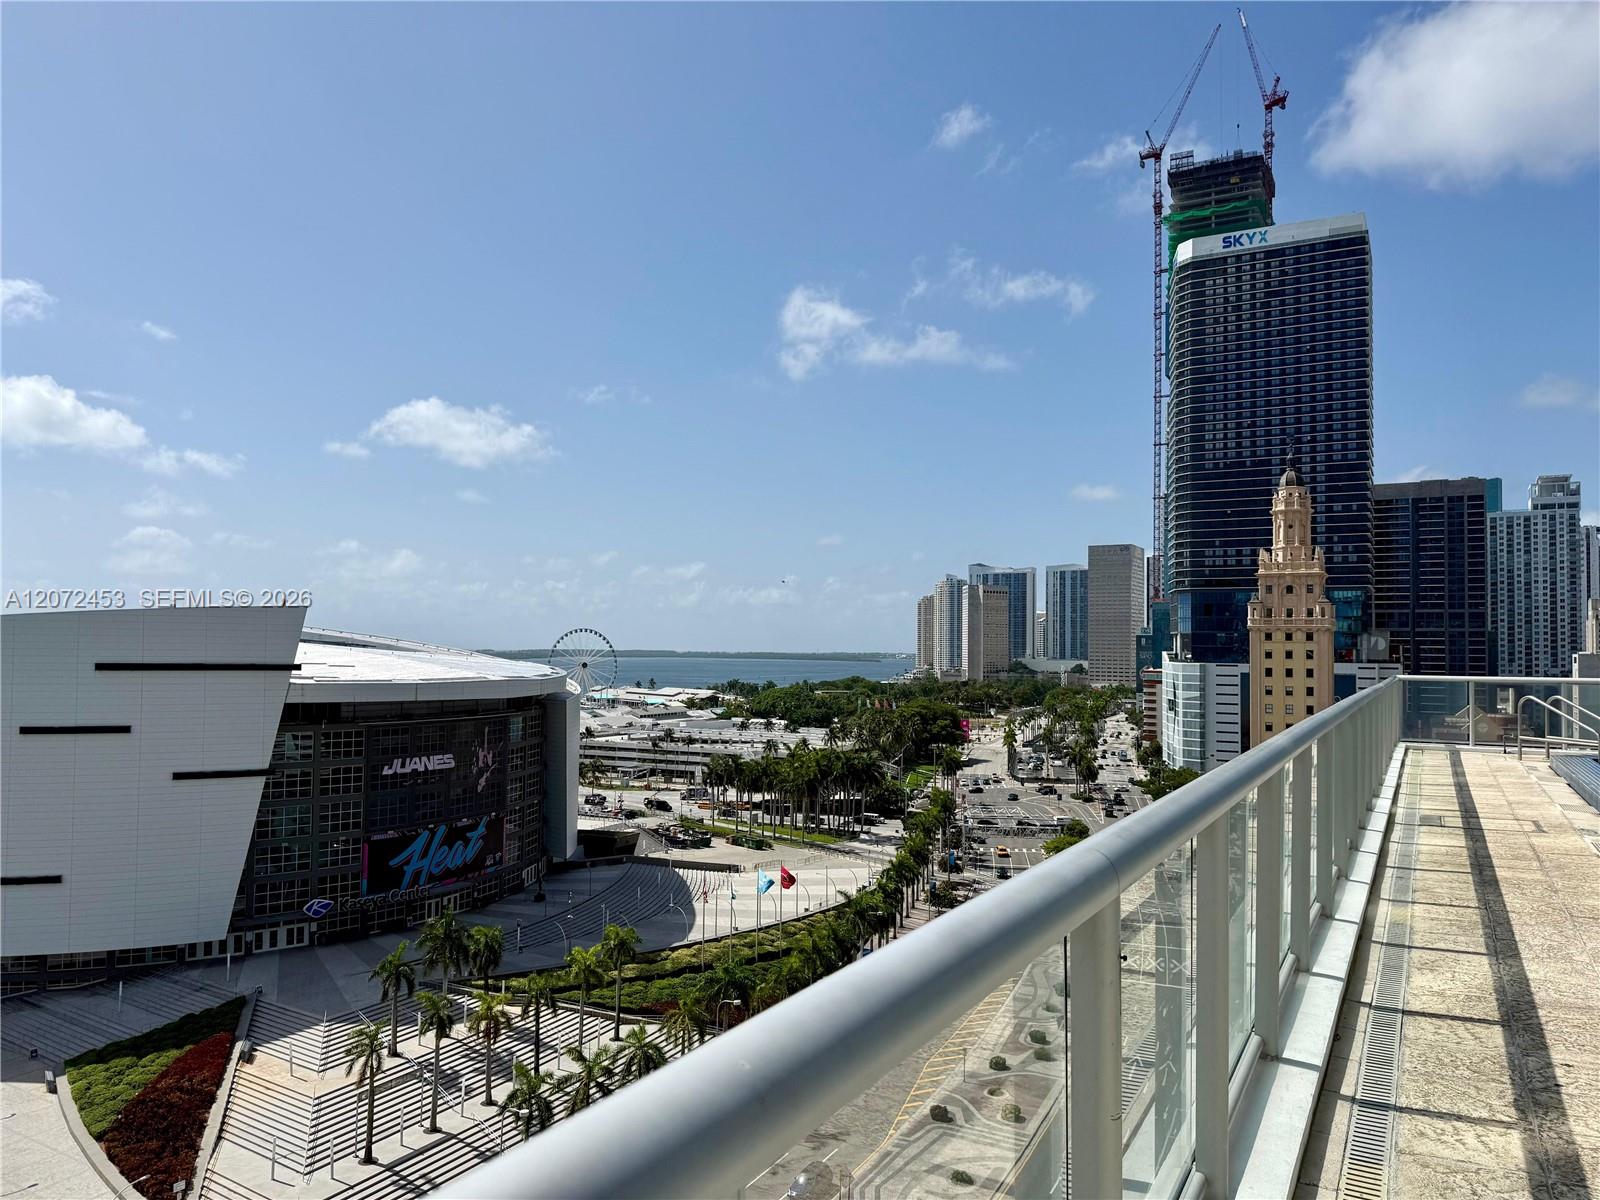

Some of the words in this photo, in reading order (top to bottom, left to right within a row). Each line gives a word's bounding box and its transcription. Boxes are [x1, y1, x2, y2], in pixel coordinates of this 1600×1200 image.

[1222, 230, 1269, 249] SKYX
[382, 754, 456, 775] JUANES
[388, 816, 489, 893] Heat
